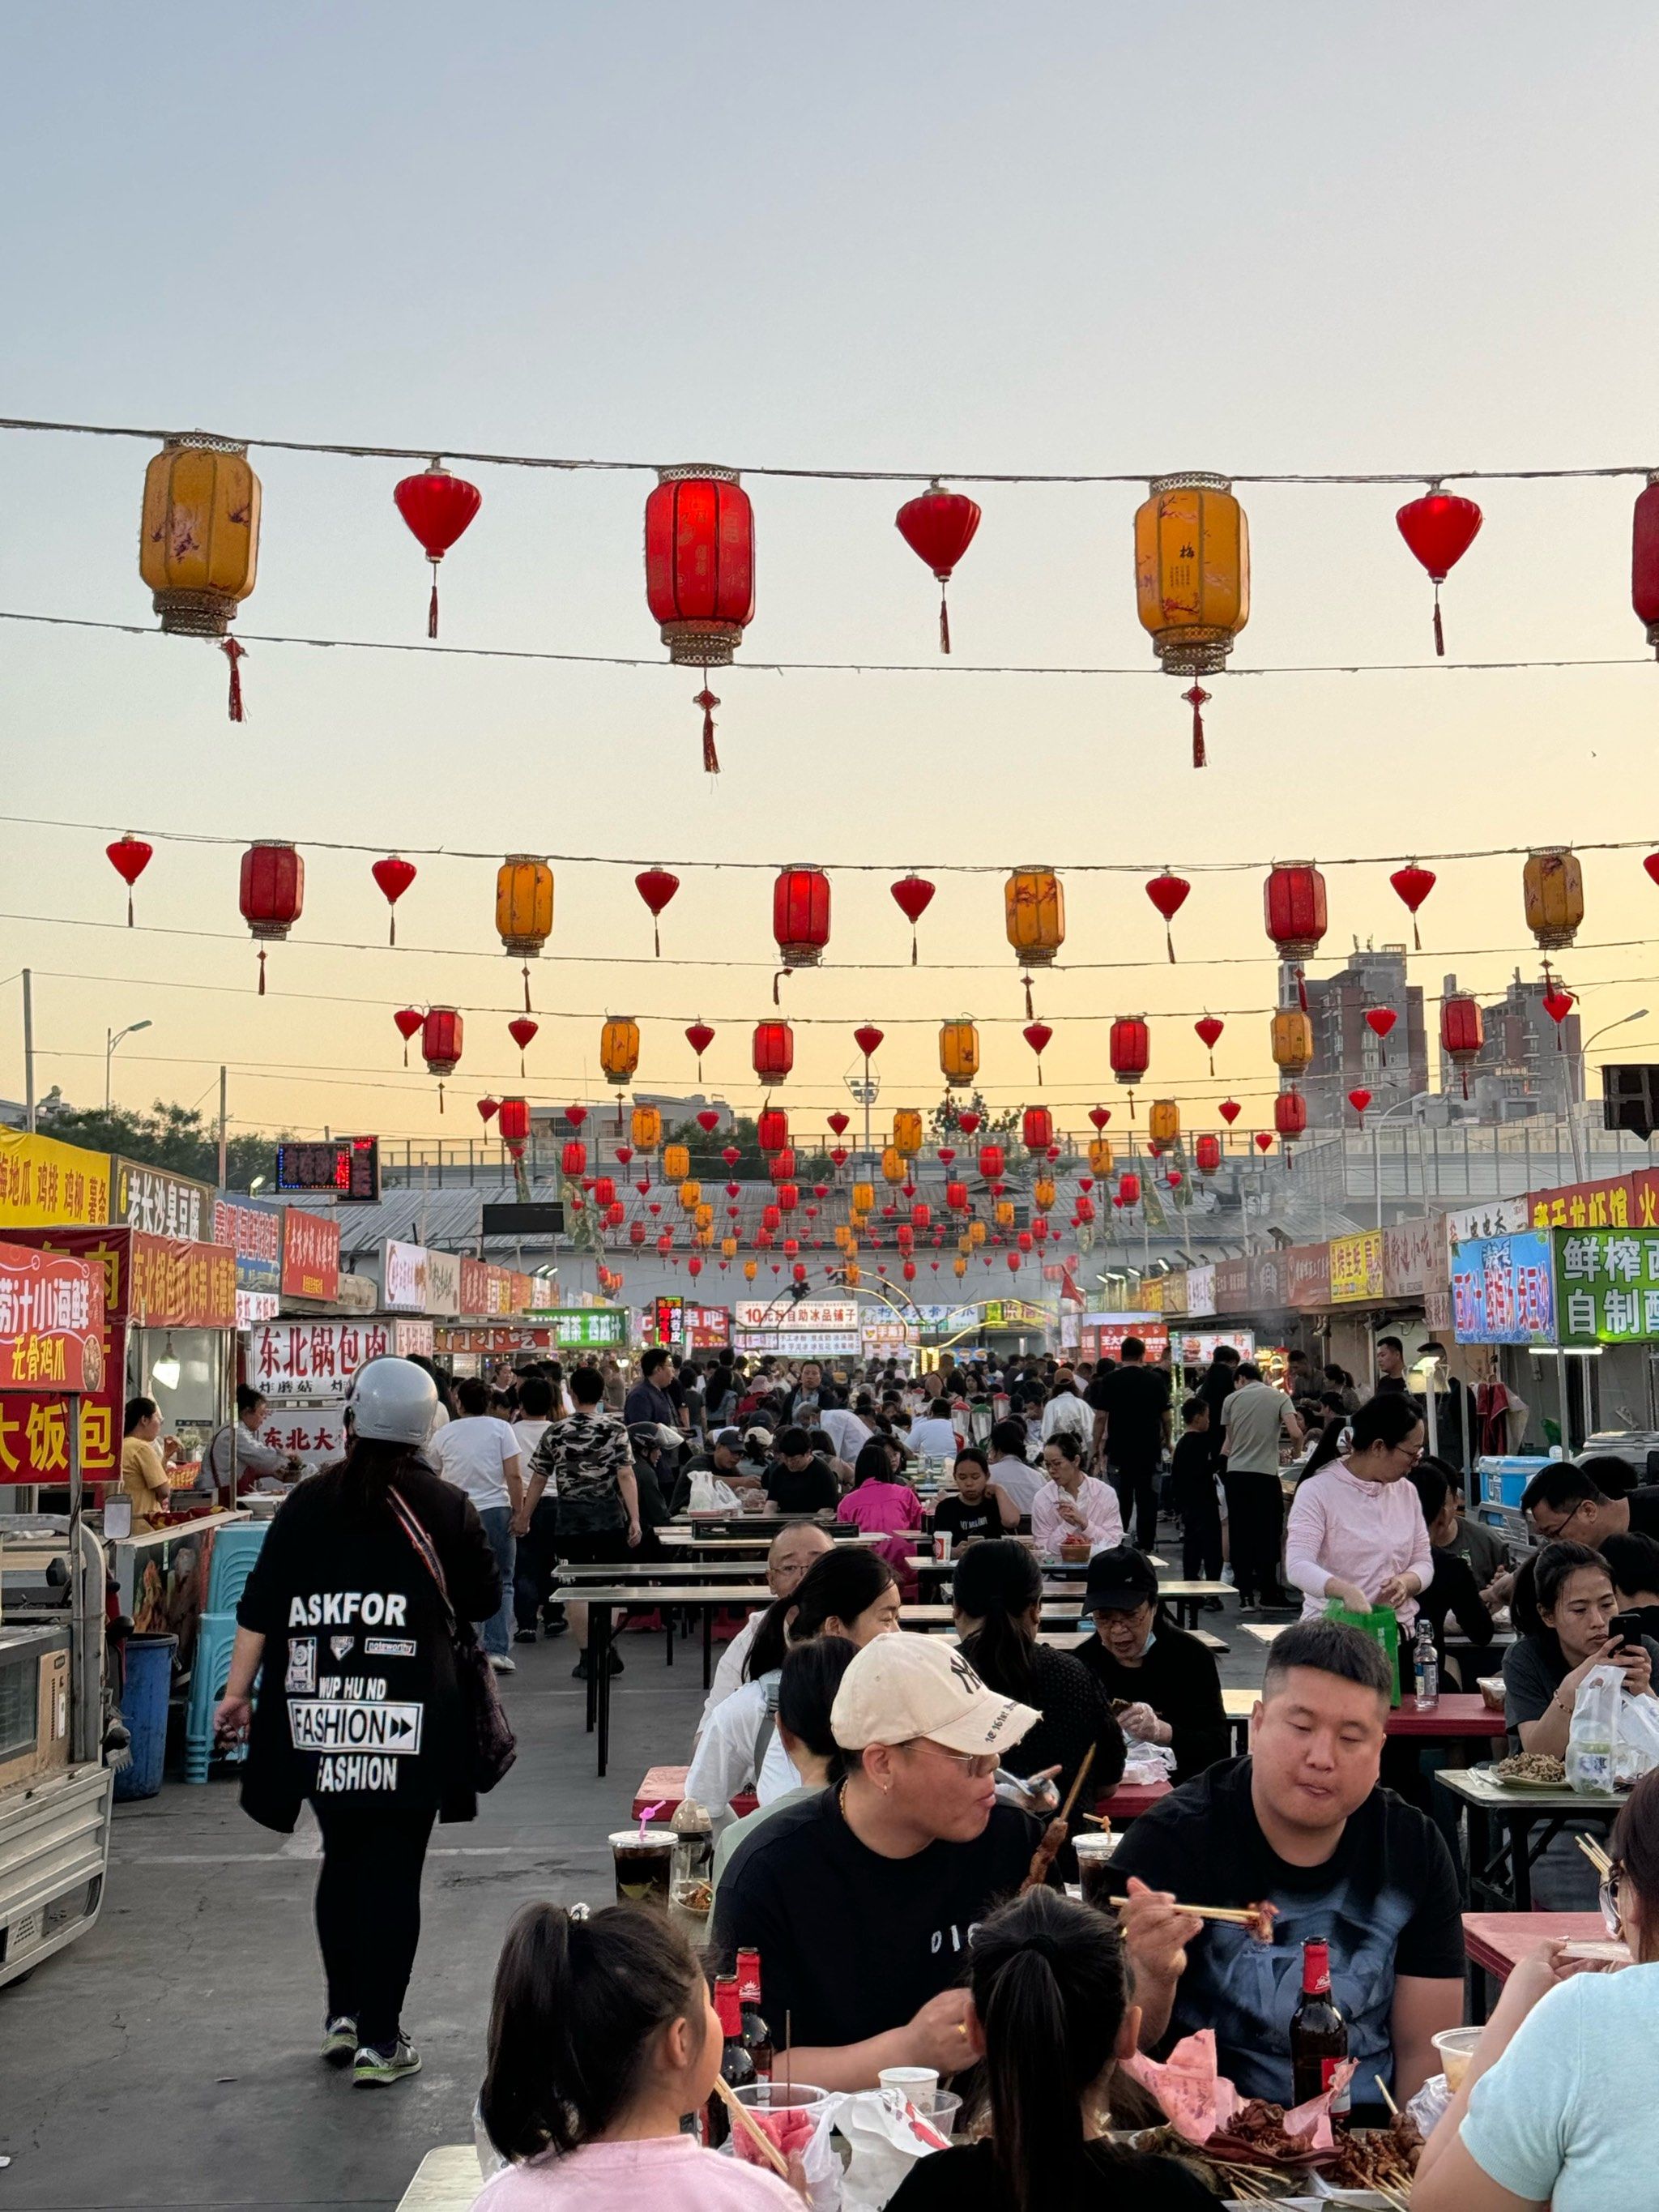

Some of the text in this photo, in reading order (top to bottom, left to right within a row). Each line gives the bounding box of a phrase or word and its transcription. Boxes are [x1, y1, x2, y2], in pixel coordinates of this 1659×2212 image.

[37, 1160, 59, 1214] 鸡排
[127, 1169, 202, 1243] 老长沙臭豆腐
[132, 1243, 188, 1317] 东北锅包肉
[11, 1333, 66, 1381] 无骨鸡爪
[257, 1324, 387, 1378] 东北锅包肉
[433, 1328, 537, 1352] 门小吃
[258, 1380, 313, 1394] 炸蘑菇
[263, 1427, 344, 1452] 东北大
[288, 1592, 409, 1629] ASKFOR
[295, 1708, 387, 1745] FASHION
